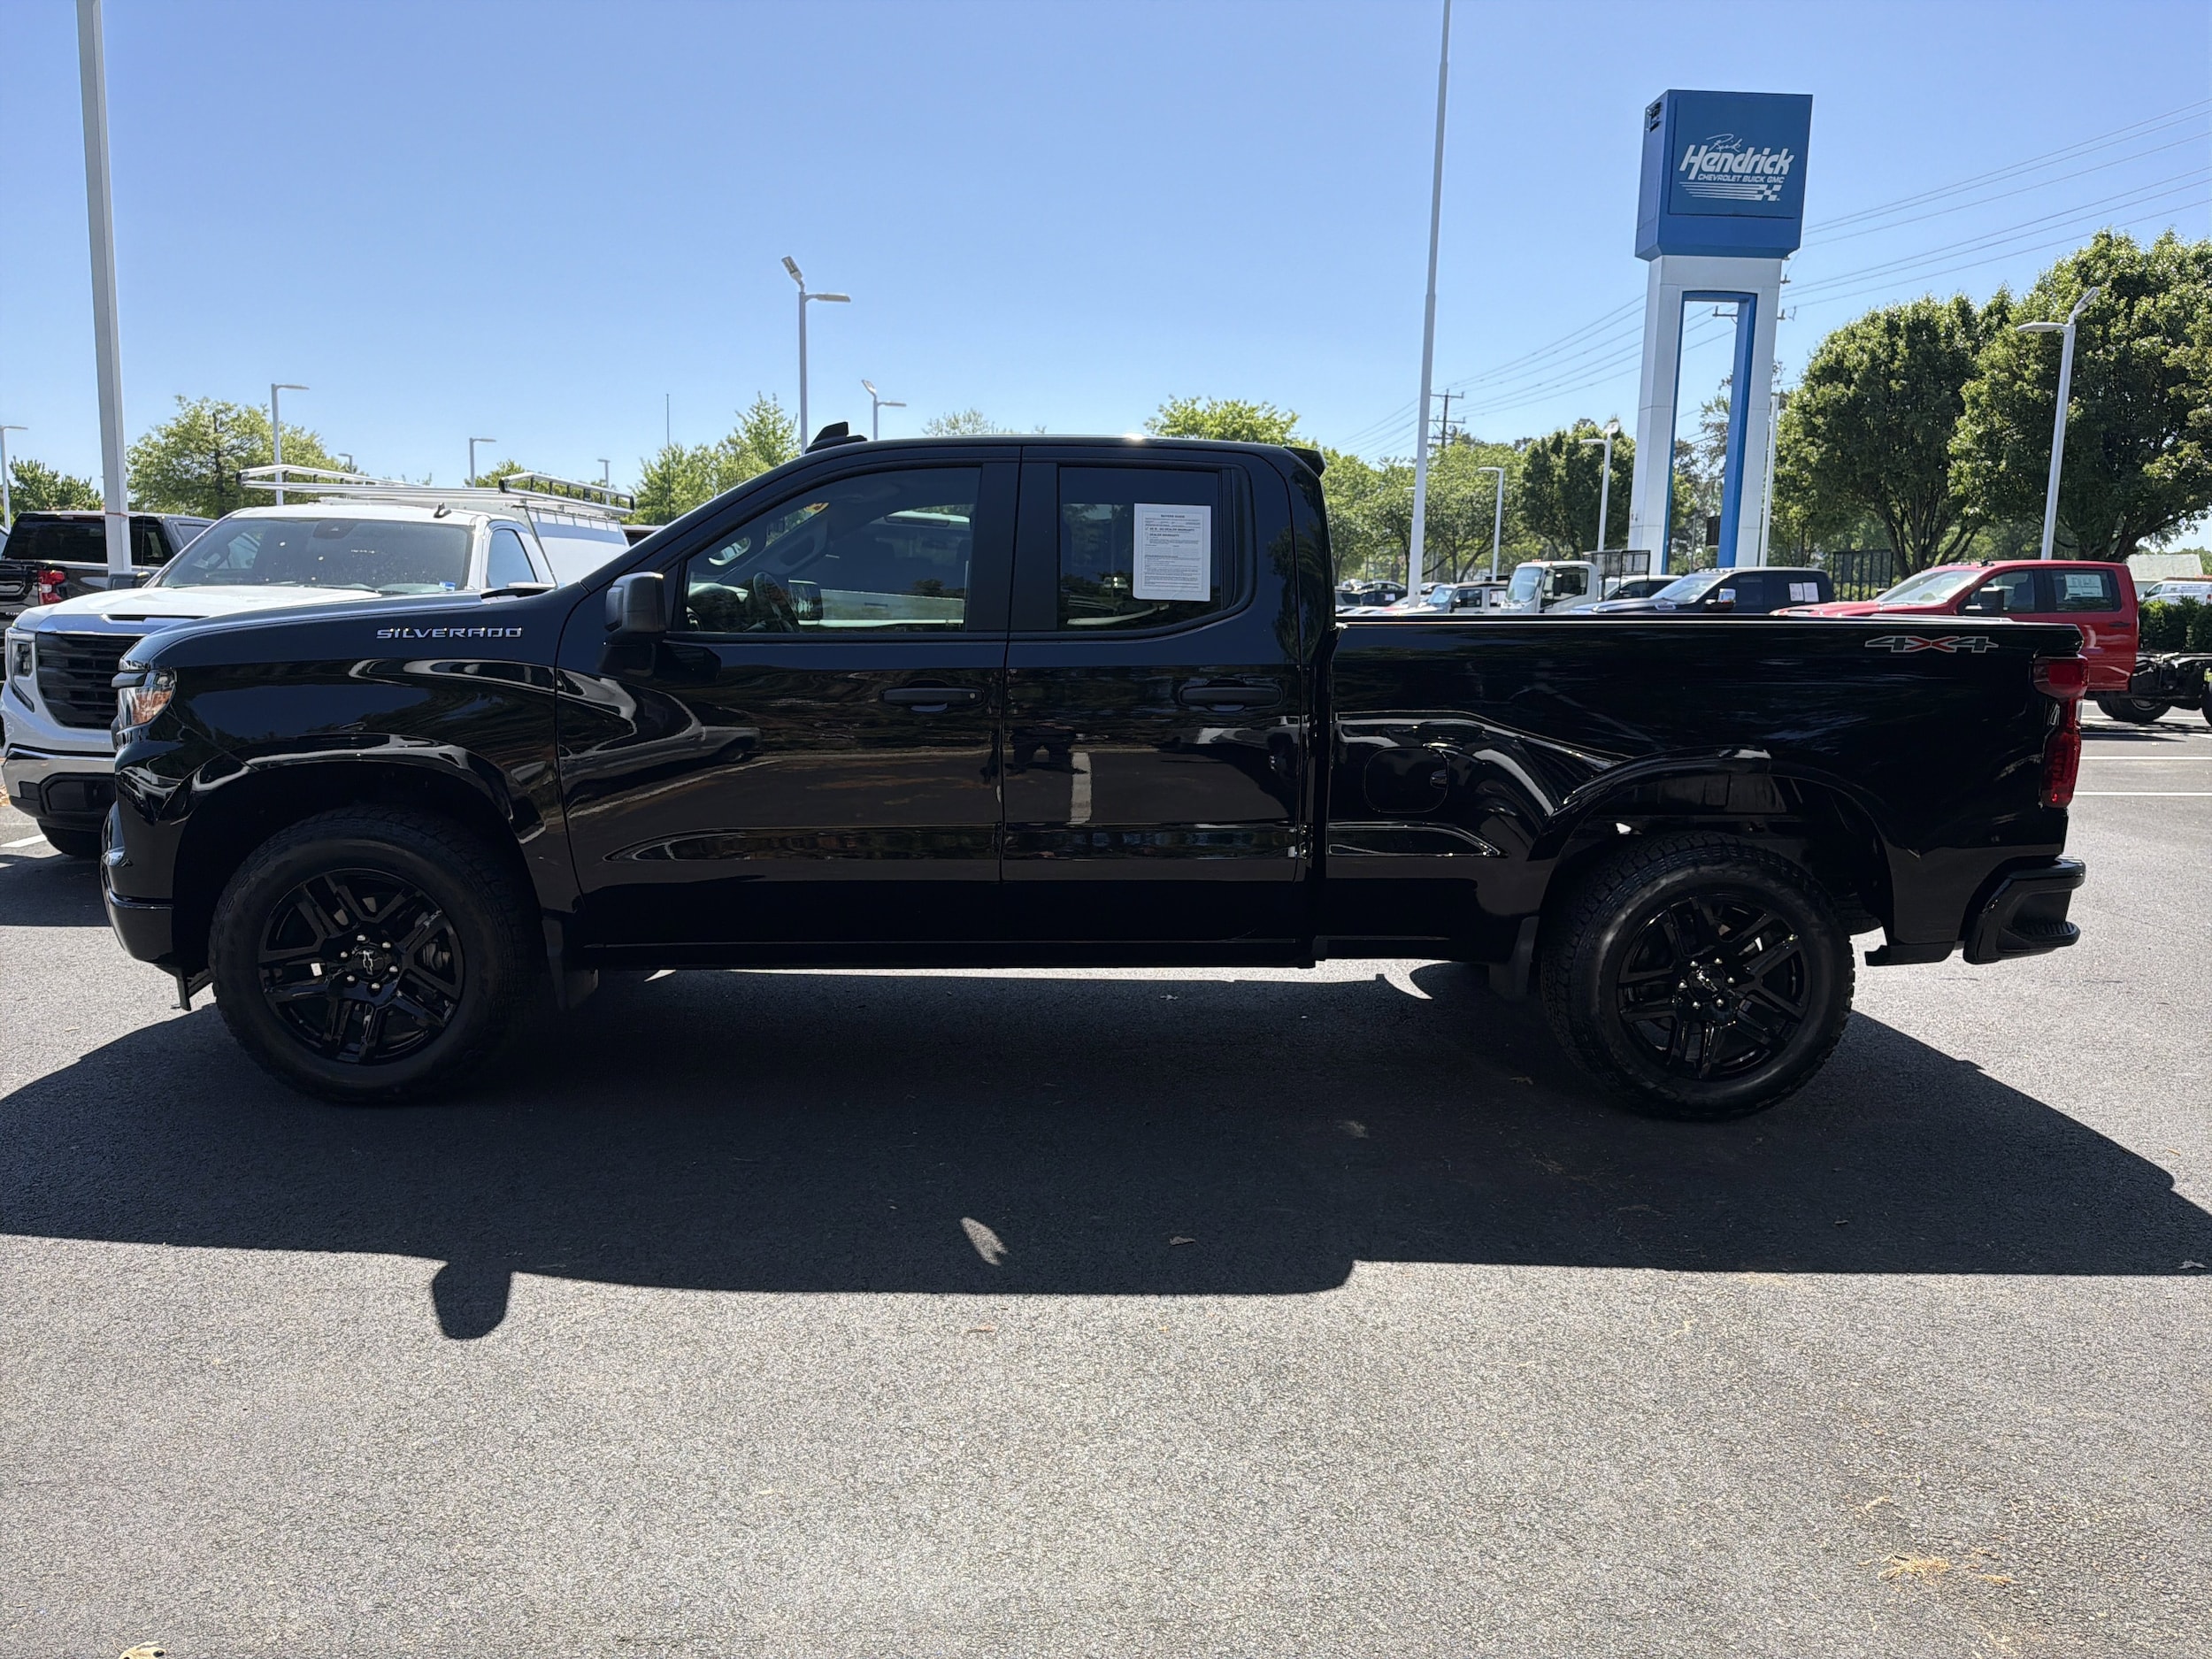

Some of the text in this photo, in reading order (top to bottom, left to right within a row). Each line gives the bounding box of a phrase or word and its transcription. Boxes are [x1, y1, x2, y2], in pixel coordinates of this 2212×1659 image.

[1679, 144, 1794, 180] Hendrick
[1698, 173, 1741, 182] CHEVROLET
[376, 627, 523, 639] SILVERADO
